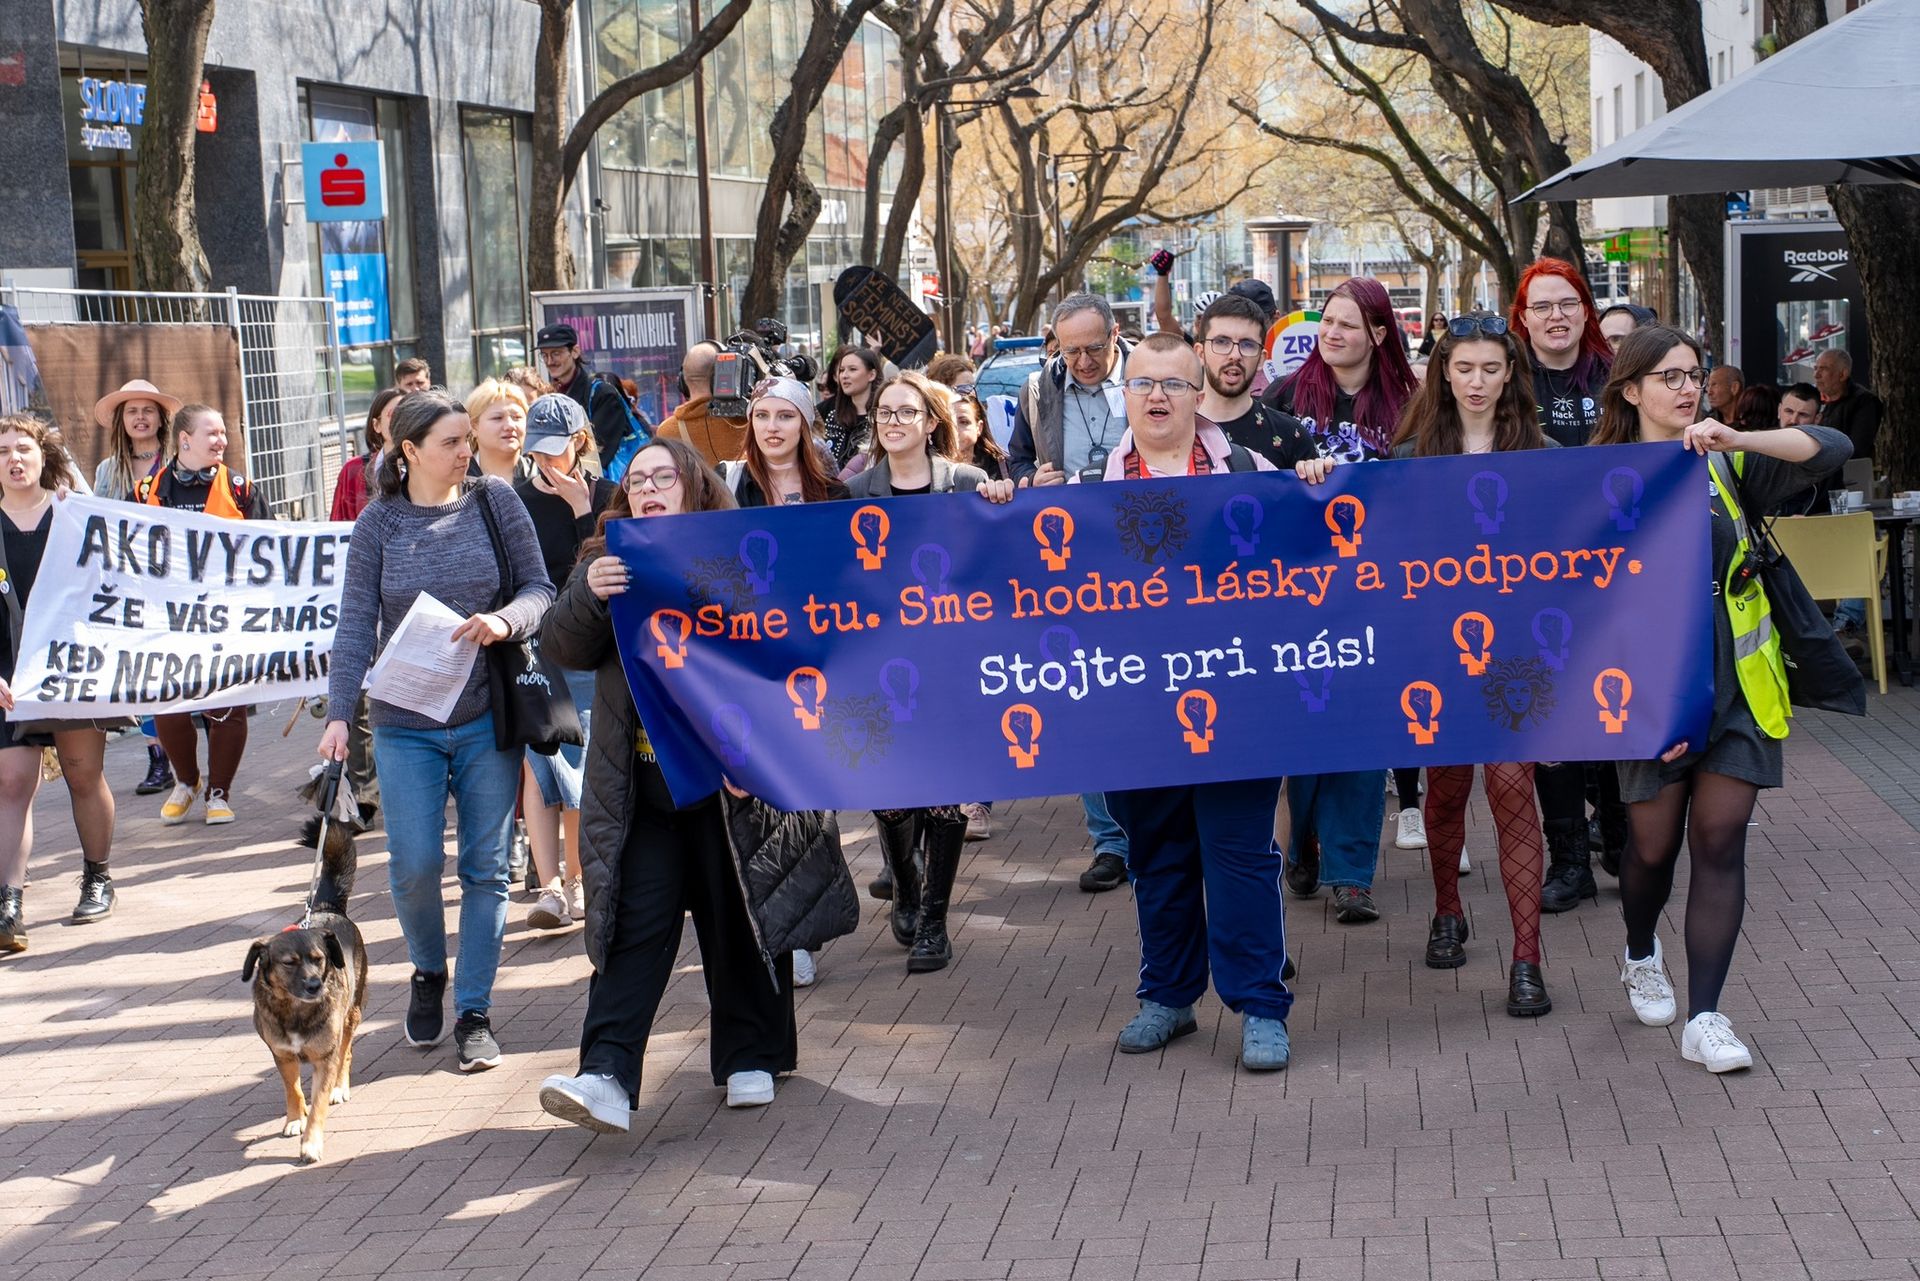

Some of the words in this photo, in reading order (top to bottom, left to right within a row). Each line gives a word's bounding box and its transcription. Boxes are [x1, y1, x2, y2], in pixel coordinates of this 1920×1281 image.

[1783, 248, 1849, 264] Reebok
[854, 285, 920, 345] FEMINIST
[868, 274, 888, 294] WE
[888, 291, 921, 327] NEED
[597, 315, 607, 350] V
[610, 311, 677, 349] ISTANBULE
[1552, 410, 1574, 419] Hack
[77, 515, 172, 578] AKO
[88, 583, 145, 629] ŽE
[166, 592, 229, 633] VÁS
[696, 604, 788, 641] Sme
[803, 593, 881, 635] tu.
[899, 585, 993, 626] Sme
[1008, 566, 1170, 619] hodné
[1184, 558, 1338, 607] lásky
[1355, 561, 1385, 592] a
[1399, 543, 1643, 600] podpory.
[980, 646, 1146, 700] Stojte
[1161, 636, 1257, 692] pri
[1271, 625, 1376, 674] nás!
[37, 675, 98, 703] STE
